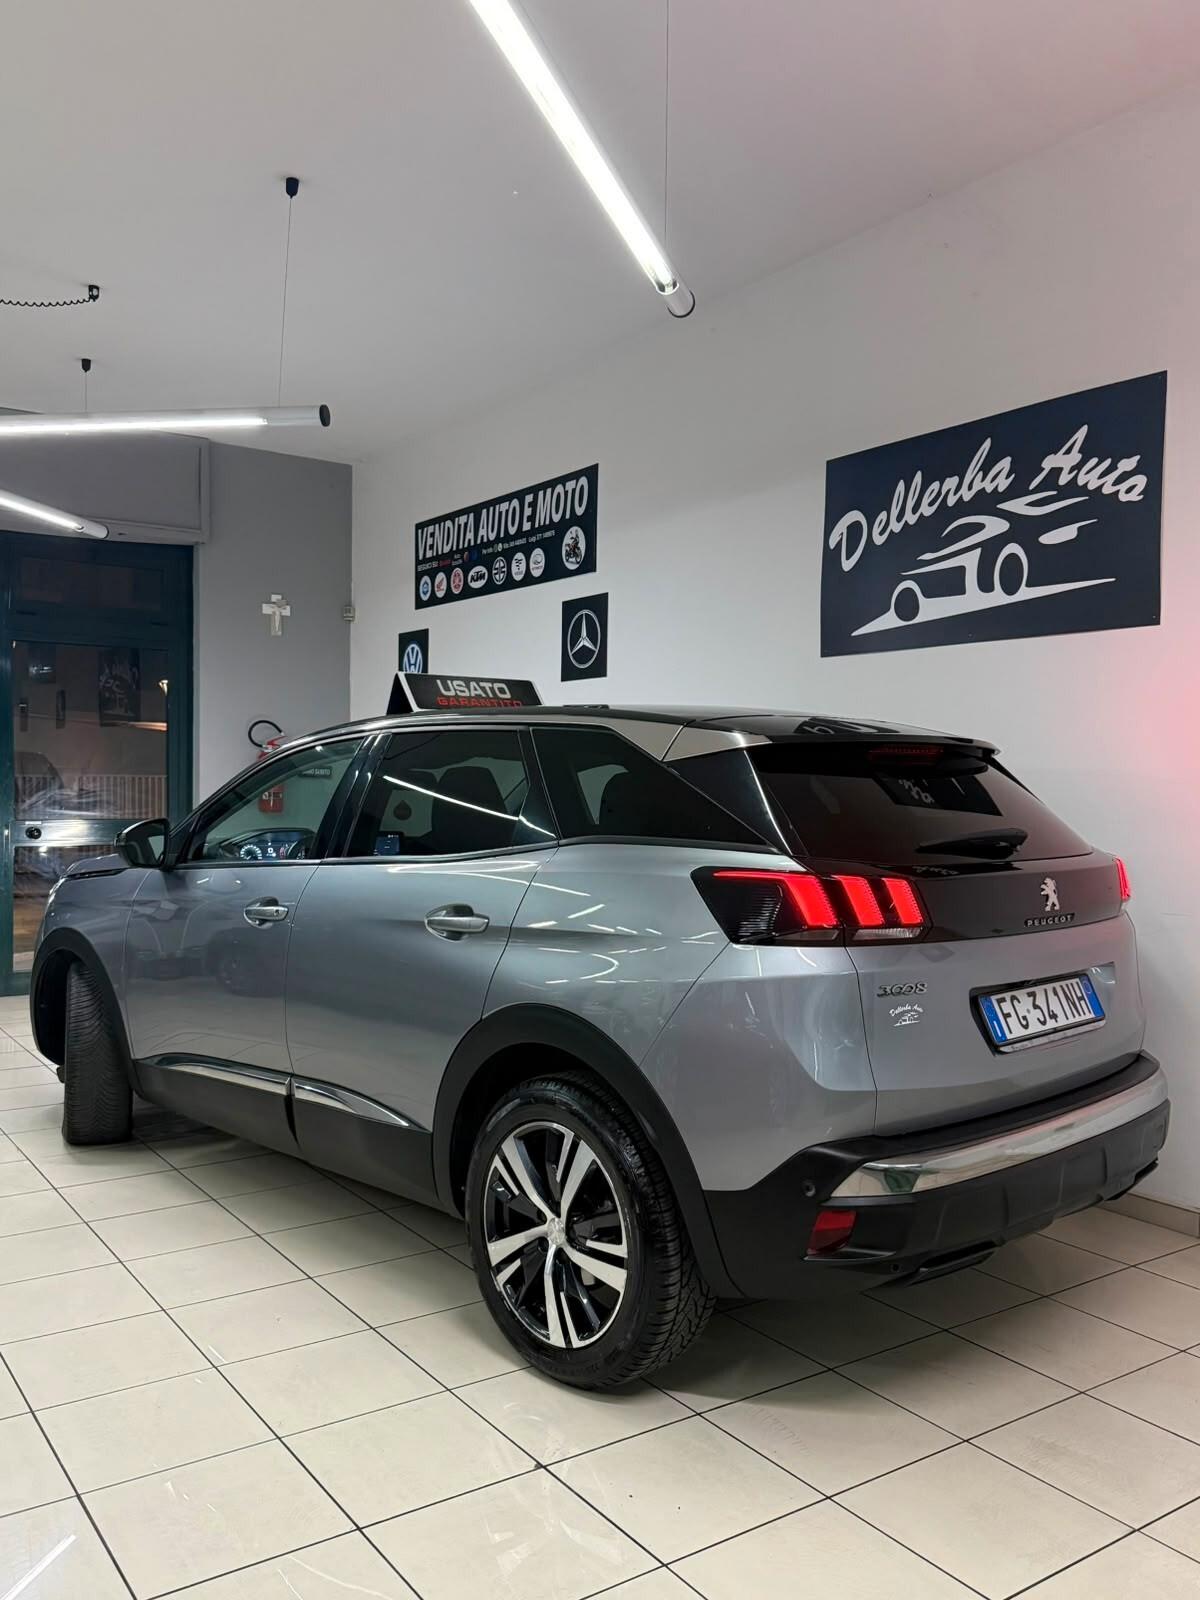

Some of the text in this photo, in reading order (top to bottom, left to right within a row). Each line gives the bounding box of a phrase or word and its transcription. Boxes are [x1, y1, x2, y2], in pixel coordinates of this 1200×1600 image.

[828, 424, 1148, 572] Dellerba Auto
[418, 476, 589, 561] VENDITA AUTO E MOTO
[470, 570, 486, 583] KTM
[436, 679, 512, 699] USATO
[437, 696, 522, 707] GARANTITO
[1027, 914, 1073, 927] PEUGEOT
[877, 982, 928, 997] 3008
